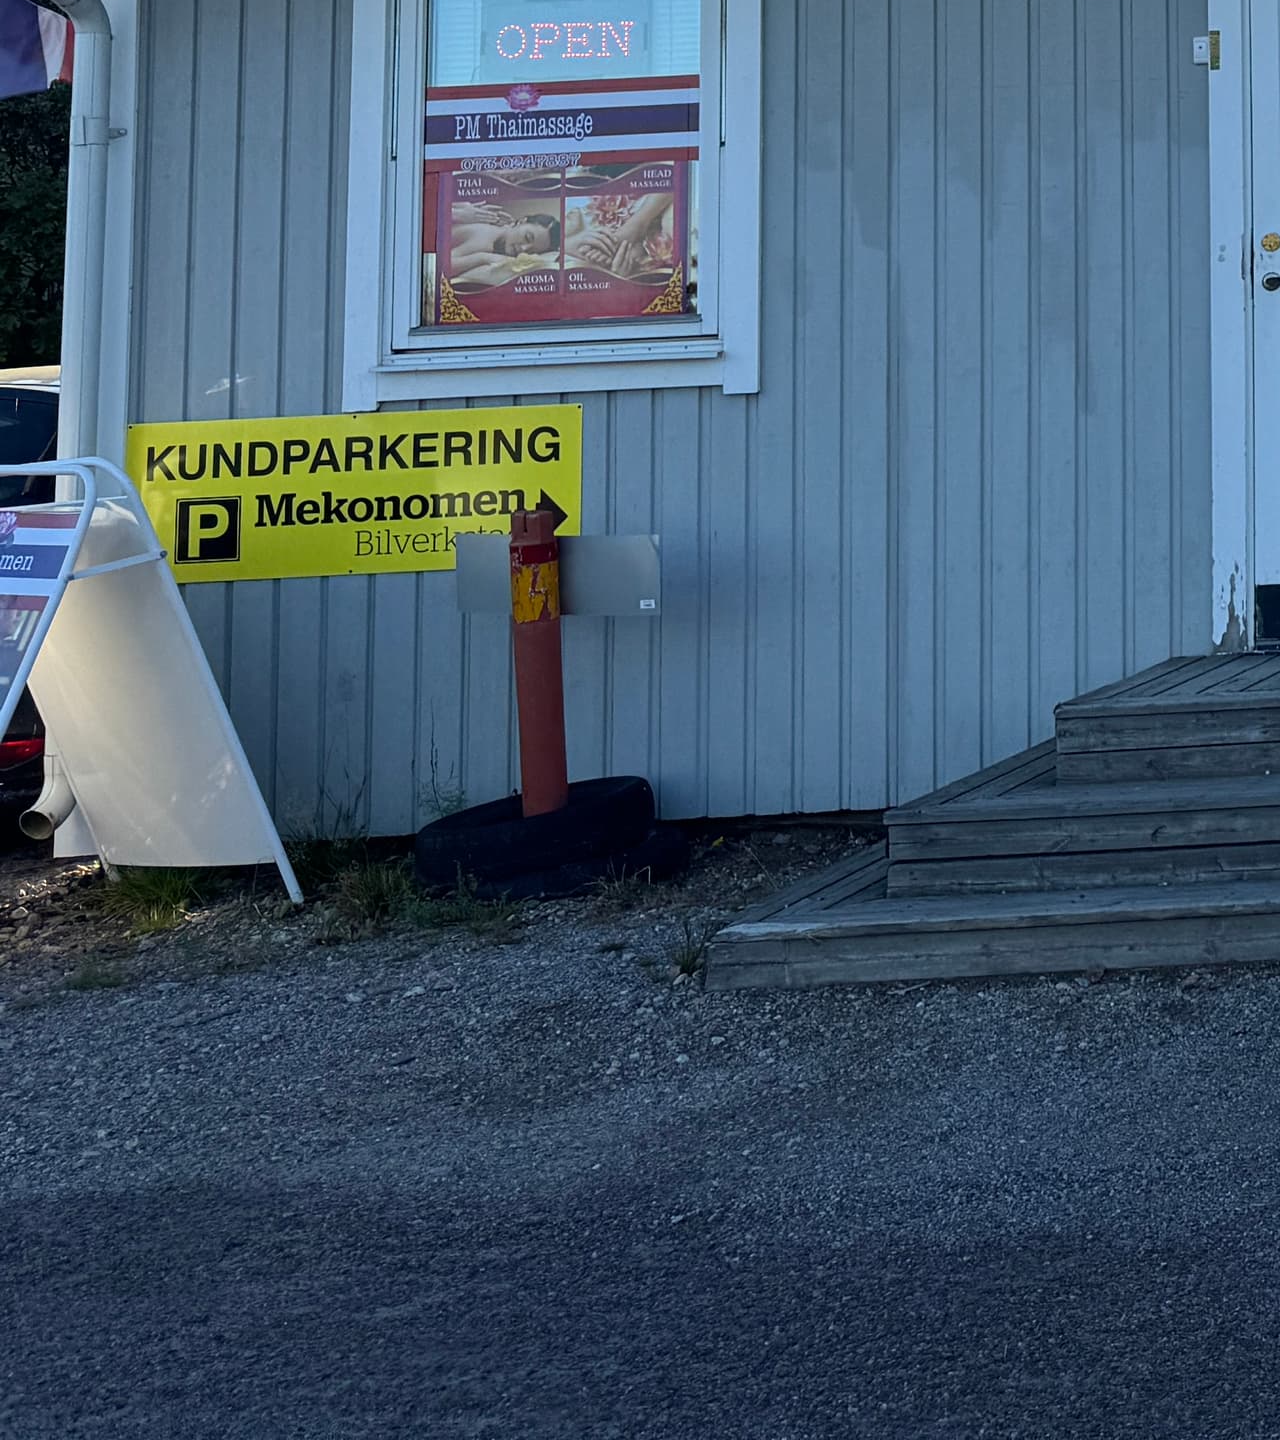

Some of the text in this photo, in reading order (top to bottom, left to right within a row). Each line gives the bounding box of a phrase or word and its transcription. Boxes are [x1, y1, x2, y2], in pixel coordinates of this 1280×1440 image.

[496, 20, 635, 60] OPEN
[454, 112, 593, 140] PM Thaimassage
[642, 169, 672, 179] HEAD
[457, 178, 482, 188] THAI
[629, 179, 672, 188] MASSAGE
[516, 274, 555, 285] AROMA
[514, 284, 556, 293] MASSAGE
[568, 282, 611, 291] MASSAGE
[145, 425, 562, 482] KUNDPARKERING
[188, 488, 526, 560] P Mekonomen
[354, 525, 512, 557] Bilverk
